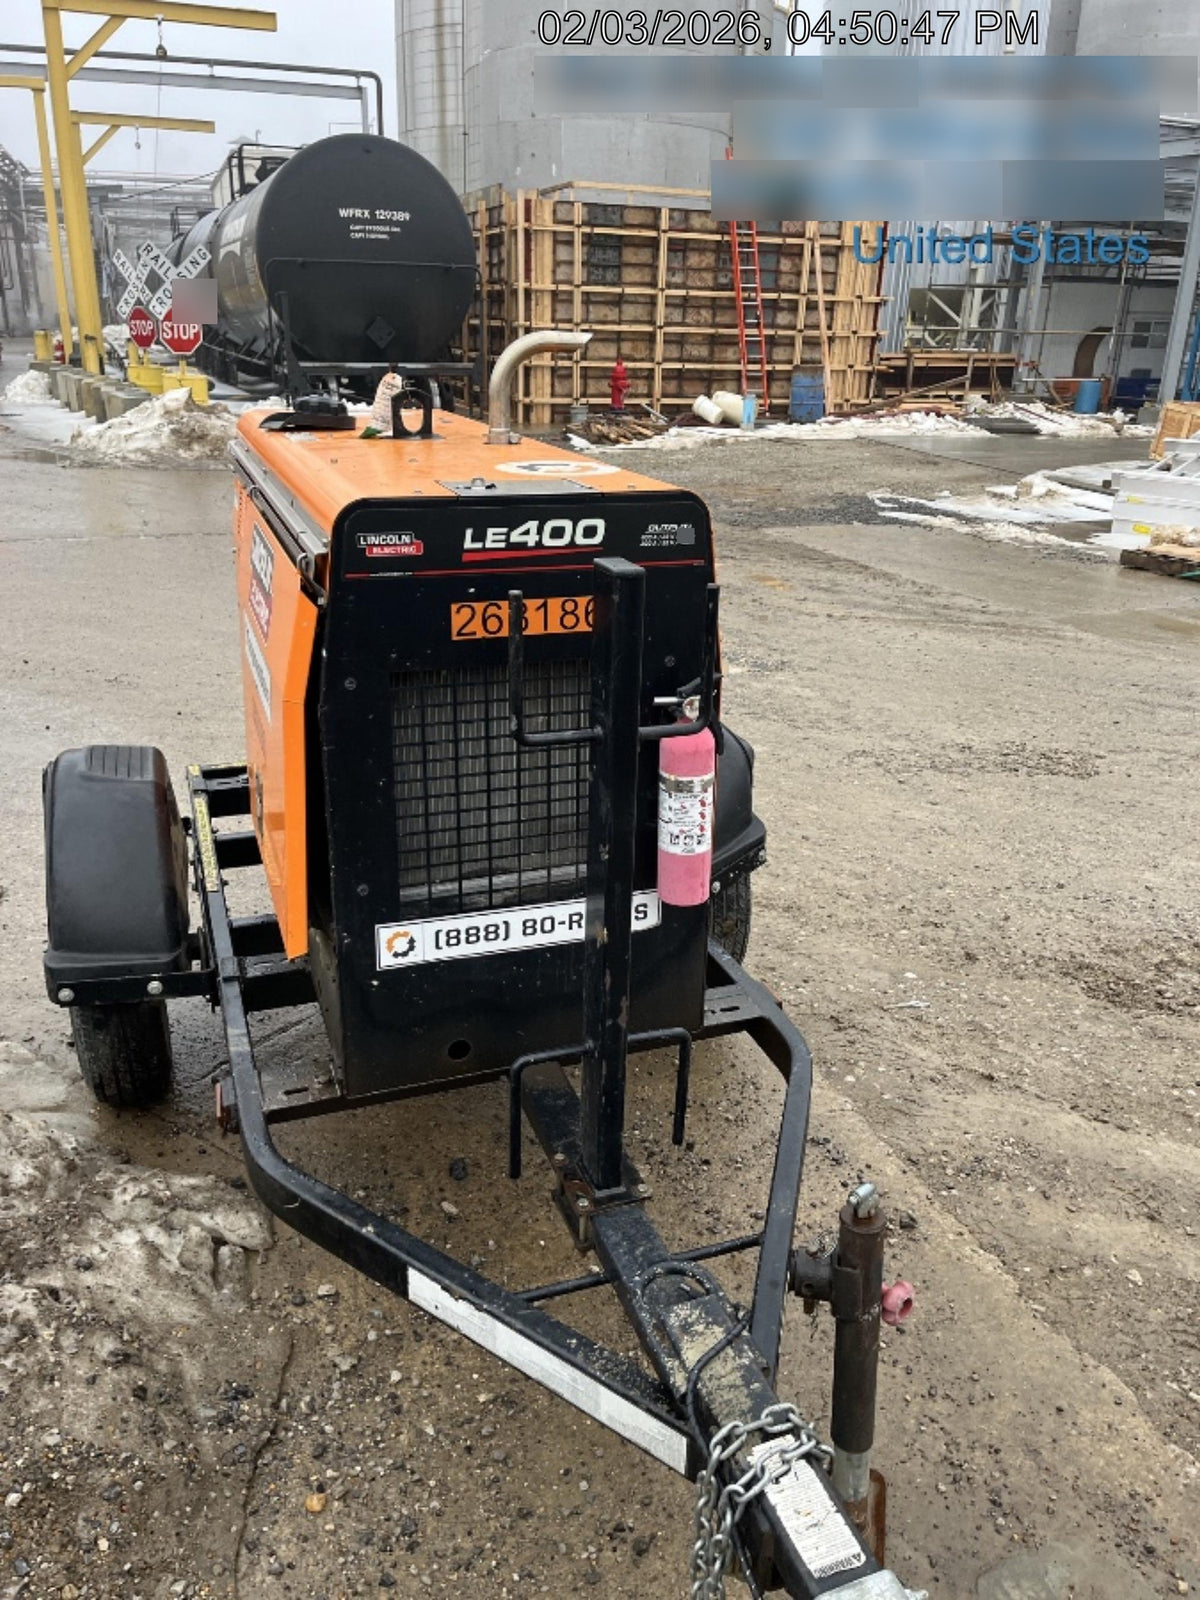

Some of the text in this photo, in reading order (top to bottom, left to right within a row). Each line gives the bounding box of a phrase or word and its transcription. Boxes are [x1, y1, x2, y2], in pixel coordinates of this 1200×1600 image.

[338, 208, 370, 219] WFRX
[115, 252, 134, 282] RAIL
[143, 244, 172, 280] RAIL
[119, 261, 149, 316] CROSSIN
[152, 248, 207, 316] CROSING
[130, 321, 154, 337] STOP
[162, 321, 199, 340] STOP
[360, 535, 412, 545] LINCOLN
[463, 518, 606, 549] LE400
[455, 598, 594, 637] 2618
[435, 903, 648, 949] (888) 80-RS
